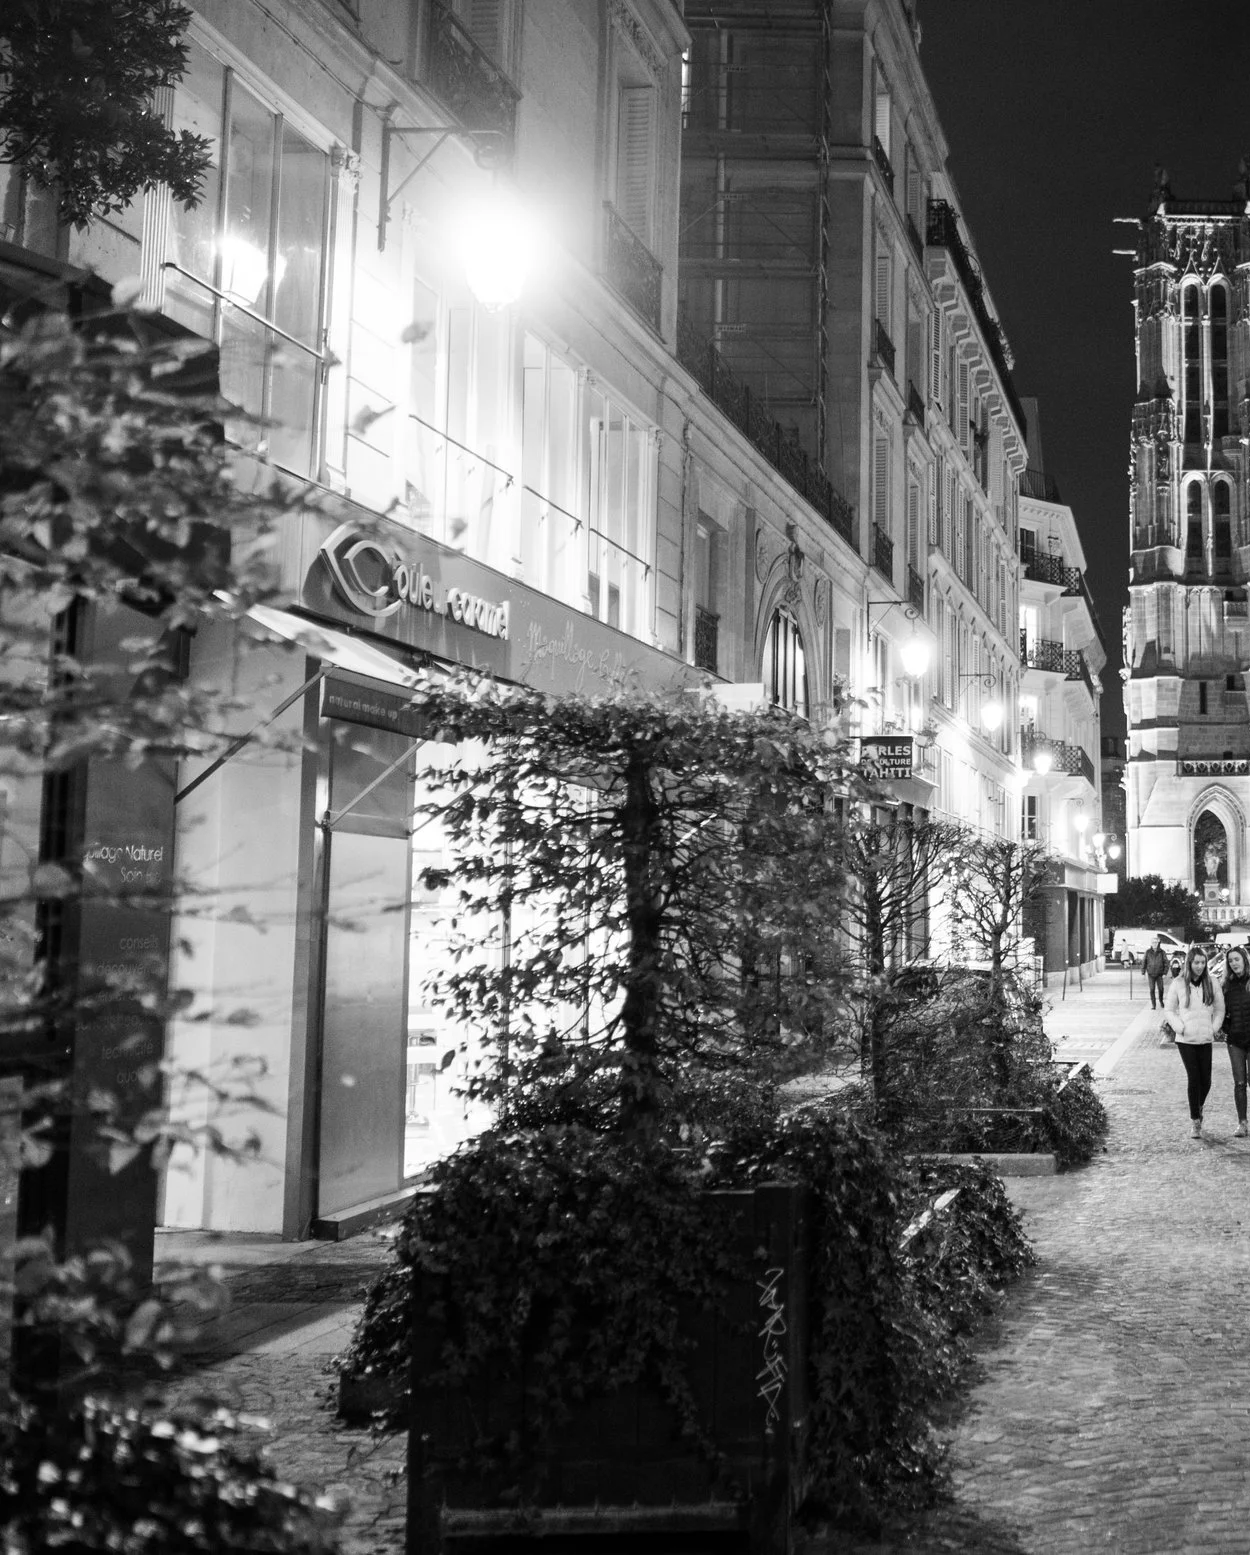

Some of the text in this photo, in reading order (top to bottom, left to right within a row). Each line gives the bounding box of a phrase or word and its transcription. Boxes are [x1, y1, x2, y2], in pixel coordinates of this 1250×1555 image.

[447, 587, 509, 640] caramel
[329, 695, 398, 722] natural make up
[861, 745, 911, 756] PRLES
[125, 844, 164, 861] Naturel
[120, 866, 143, 883] Soin
